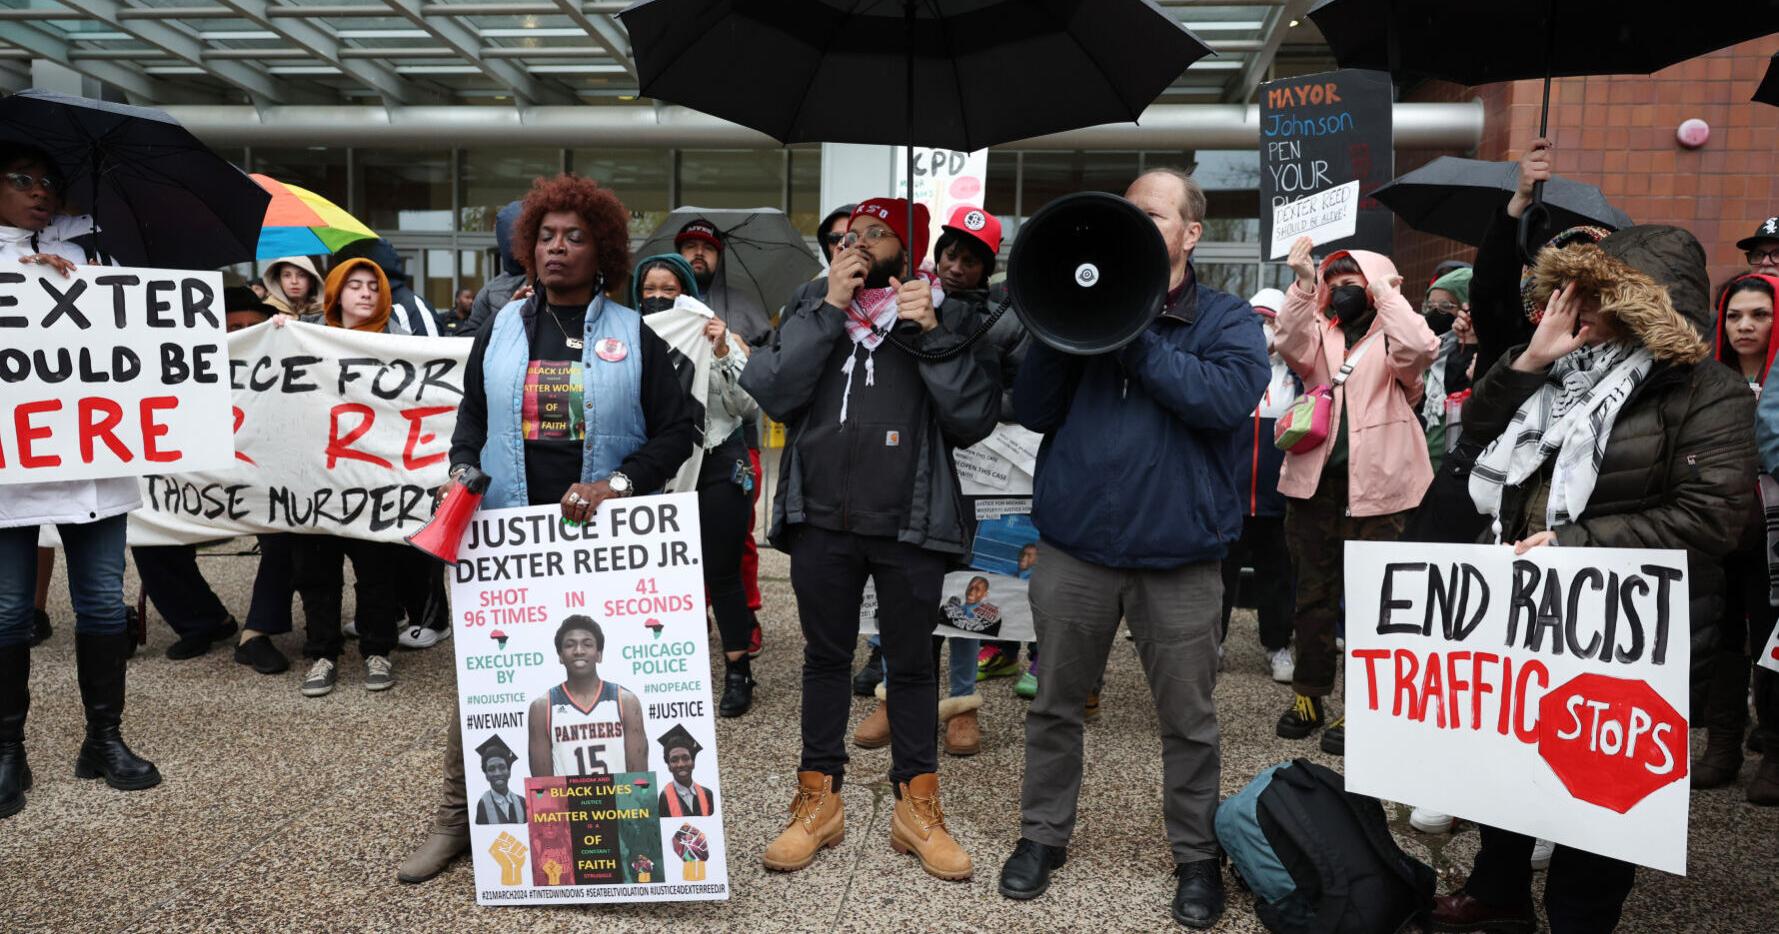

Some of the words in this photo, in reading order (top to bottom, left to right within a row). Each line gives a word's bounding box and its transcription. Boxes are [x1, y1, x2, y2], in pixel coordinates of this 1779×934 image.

[1268, 82, 1341, 109] MAYOR
[1265, 112, 1354, 137] Johnson
[1269, 140, 1301, 161] PEN
[912, 151, 966, 177] CPD
[1269, 160, 1333, 192] YOUR
[1276, 197, 1317, 224] DEXTER
[1322, 186, 1352, 210] REED
[1276, 219, 1307, 239] SHOULD
[161, 343, 218, 385] BE
[230, 355, 324, 393] ICE
[339, 358, 464, 401] FOR
[524, 384, 550, 392] ATTER
[553, 384, 584, 392] WOME
[545, 403, 558, 411] OF
[0, 395, 183, 471] ERE
[541, 421, 567, 430] FAITH
[143, 474, 251, 520] THOSE
[468, 509, 599, 550] JUSTICE
[611, 503, 680, 537] FOR
[456, 551, 564, 583] DEXTER
[574, 544, 649, 574] REED
[657, 540, 699, 567] JR.
[635, 578, 658, 594] 41
[480, 588, 529, 607] SHOT
[565, 591, 585, 608] IN
[604, 594, 694, 617] SECONDS
[464, 611, 486, 627] 96
[490, 606, 548, 625] TIMES
[1375, 562, 1490, 641] END
[1504, 559, 1684, 665] RACIST
[622, 641, 695, 660] CHICAGO
[466, 652, 544, 670] EXECUTED
[632, 658, 688, 675] POLICE
[497, 670, 515, 684] BY
[644, 681, 701, 694] #NOPEACE
[467, 692, 526, 705] #NOJUSTICE
[648, 700, 704, 720] #JUSTICE
[1351, 649, 1549, 744] TRAFFIC
[1557, 695, 1675, 775] STOPS
[467, 712, 525, 730] #WEWANT
[555, 721, 623, 742] PANTHERS
[574, 744, 608, 776] 15
[550, 785, 592, 798] BLACK
[596, 784, 632, 796] LIVES
[533, 811, 588, 823] MATTER
[592, 808, 650, 820] WOMEN
[583, 835, 602, 846] OF
[578, 859, 616, 870] FAITH
[482, 889, 528, 900] #21MARCH2024
[529, 888, 585, 899] #TINTEDWINDOWS
[586, 886, 650, 898] #SEATBELTVIOLATION
